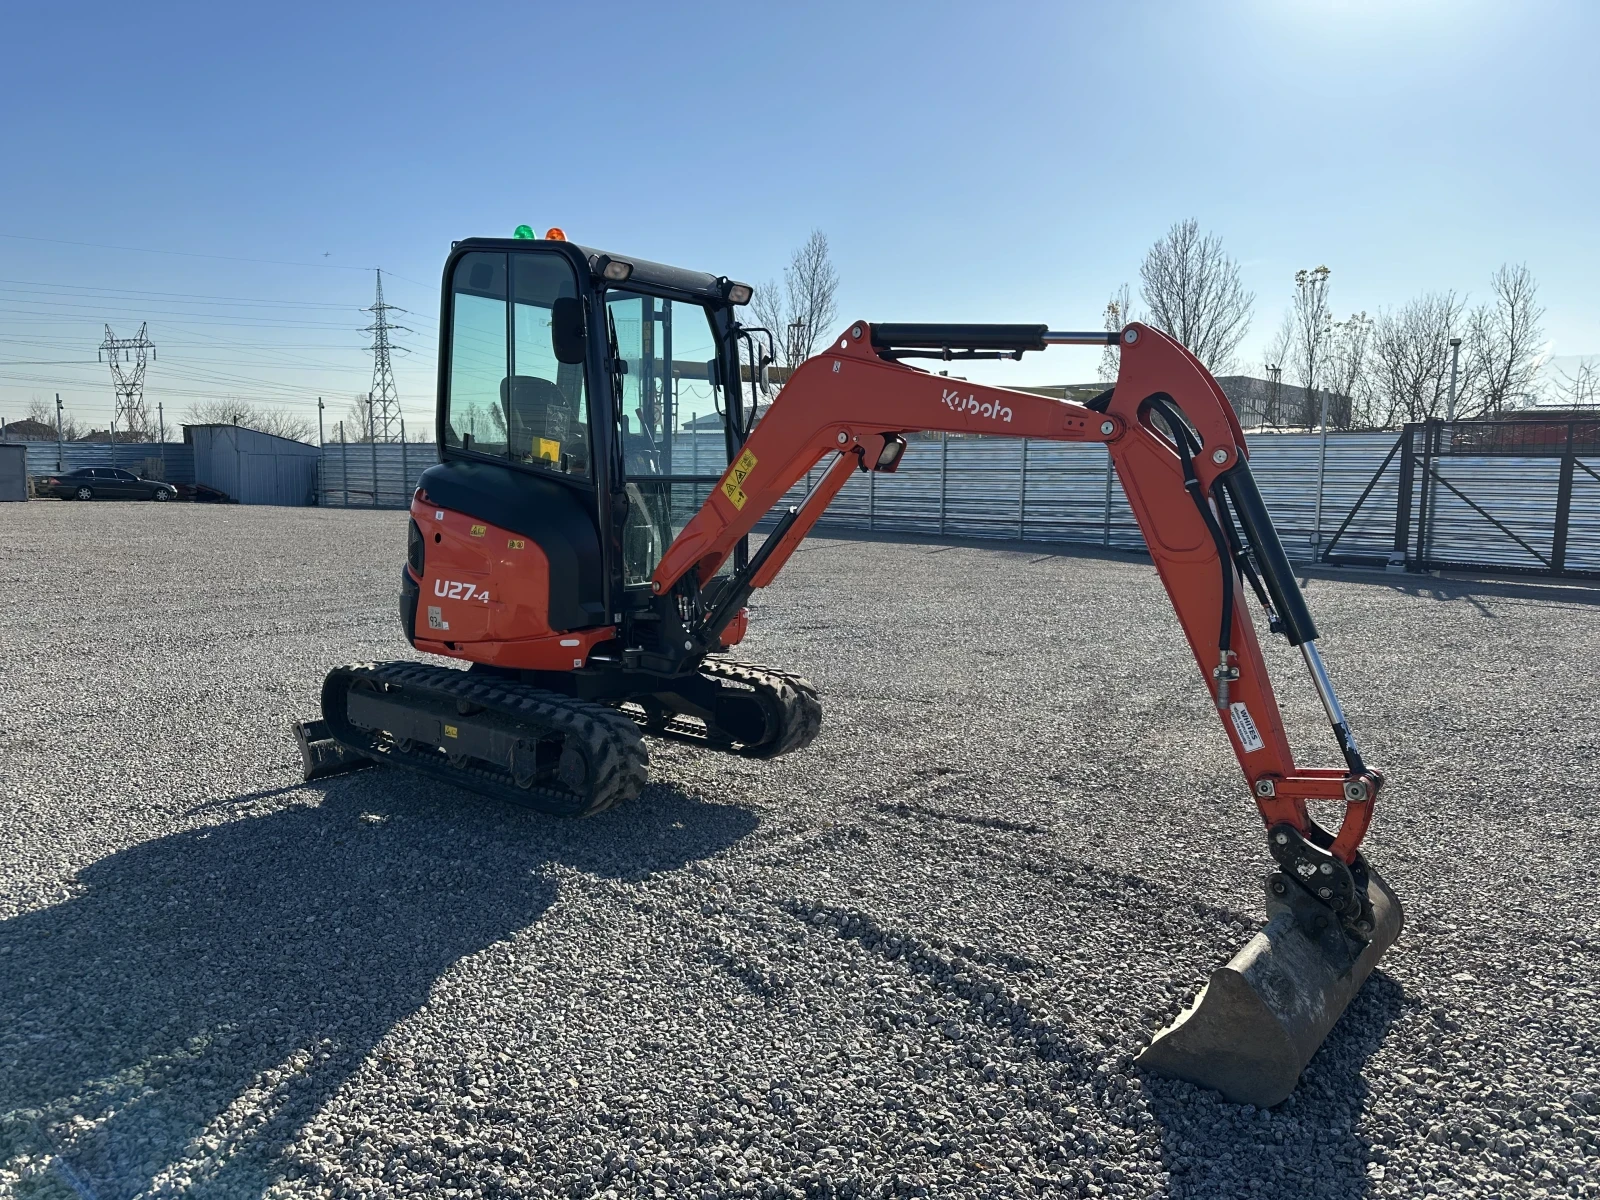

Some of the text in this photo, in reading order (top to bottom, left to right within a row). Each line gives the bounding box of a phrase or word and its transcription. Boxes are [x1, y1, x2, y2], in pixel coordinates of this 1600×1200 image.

[941, 389, 1013, 423] Kubota
[434, 579, 490, 603] U27-4
[1240, 709, 1258, 740] WHITES
